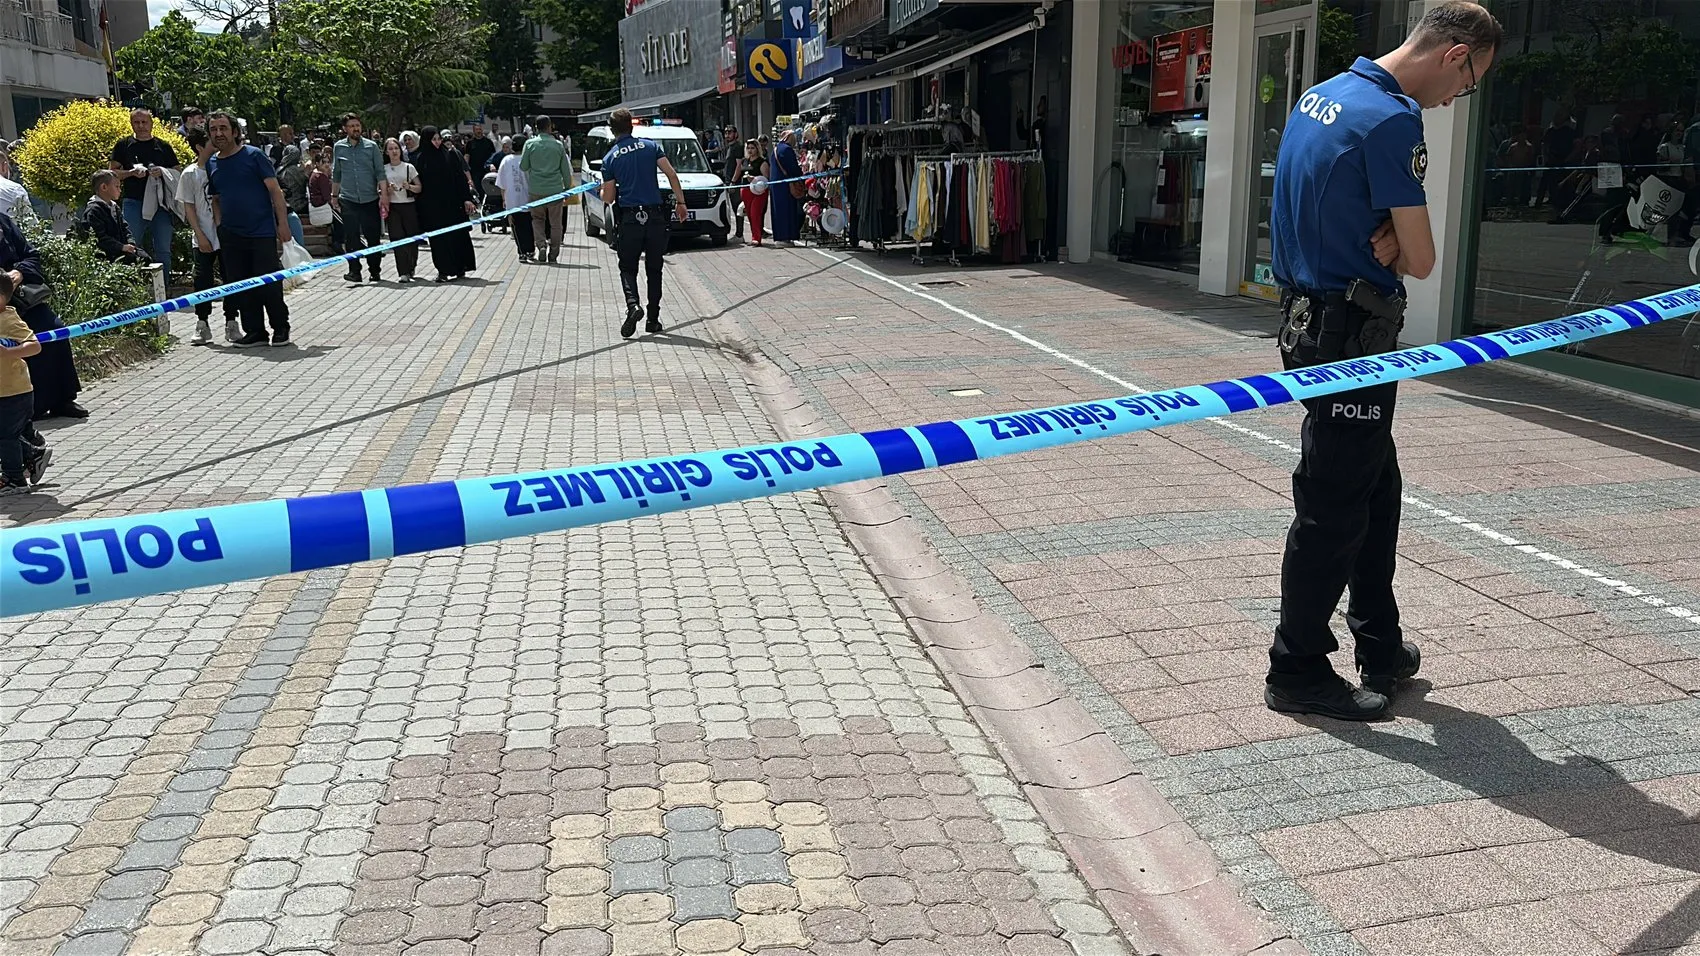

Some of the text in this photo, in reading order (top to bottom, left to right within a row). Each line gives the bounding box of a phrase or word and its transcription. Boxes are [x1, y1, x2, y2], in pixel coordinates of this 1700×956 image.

[640, 27, 689, 75] SİTARE
[1112, 40, 1149, 68] VESTEL
[1281, 349, 1443, 387] POLİS GİRİLMEZ
[976, 391, 1200, 441] POLİS GİRİLMEZ
[490, 442, 843, 517] POLİS GİRİLMEZ
[12, 517, 224, 595] POLİS
